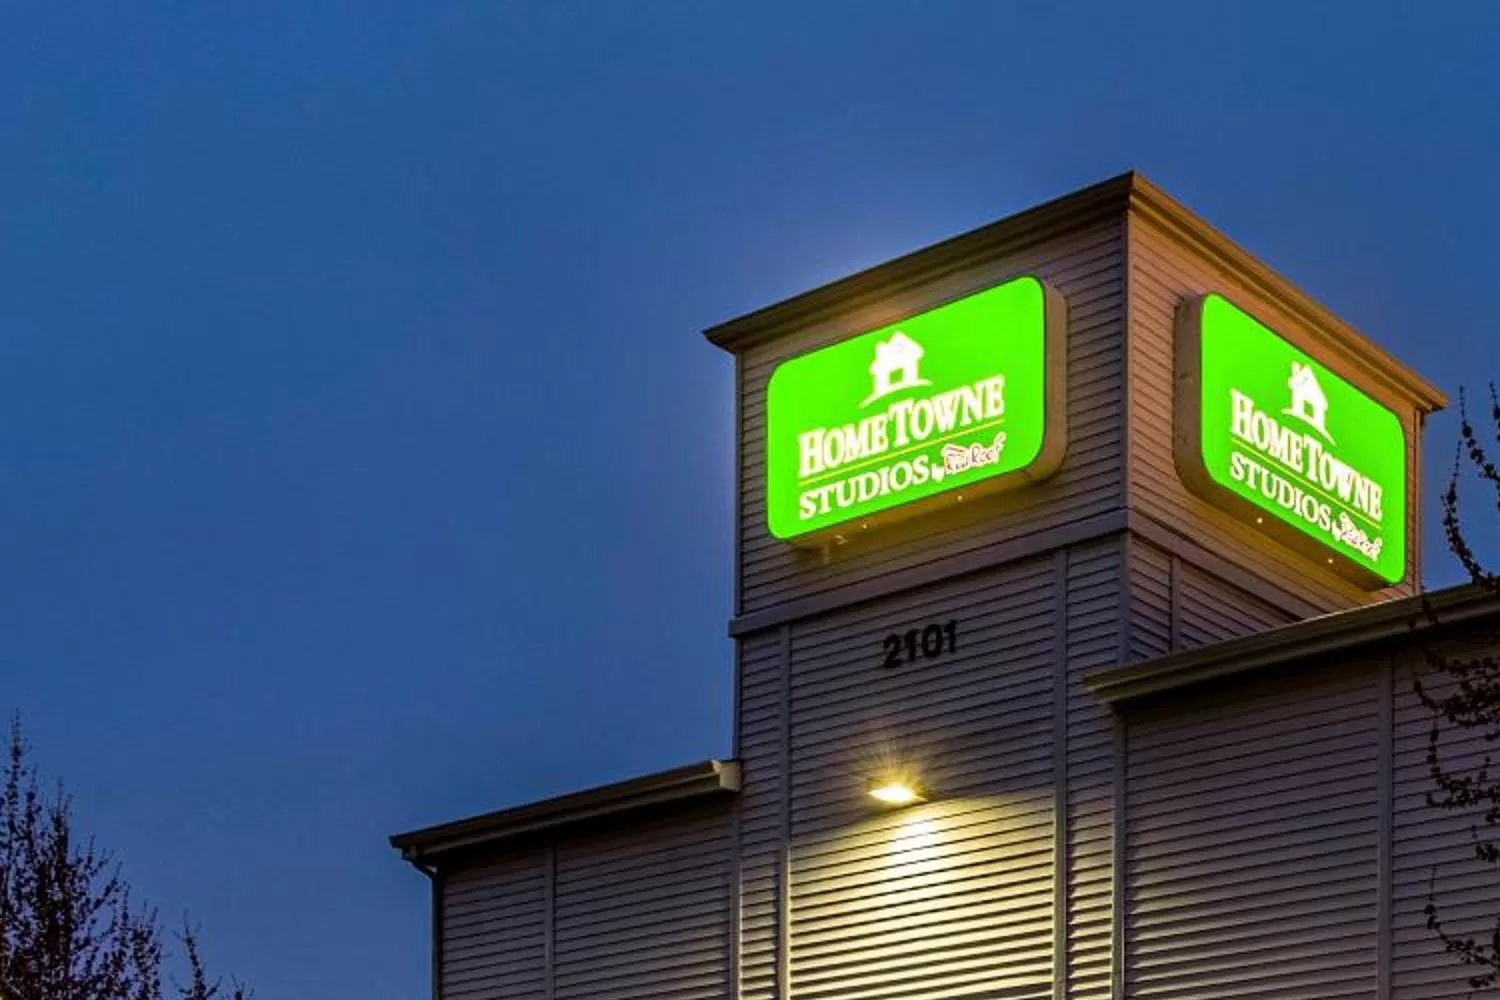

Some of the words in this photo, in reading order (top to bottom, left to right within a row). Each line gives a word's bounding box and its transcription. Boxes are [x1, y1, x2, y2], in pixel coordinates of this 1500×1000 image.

[798, 374, 1005, 478] HOMETOWNE
[1229, 387, 1383, 521] HOMETOWNE
[799, 455, 929, 520] STUDIOS
[1230, 452, 1331, 532] STUDIOS
[883, 619, 957, 669] 2101
